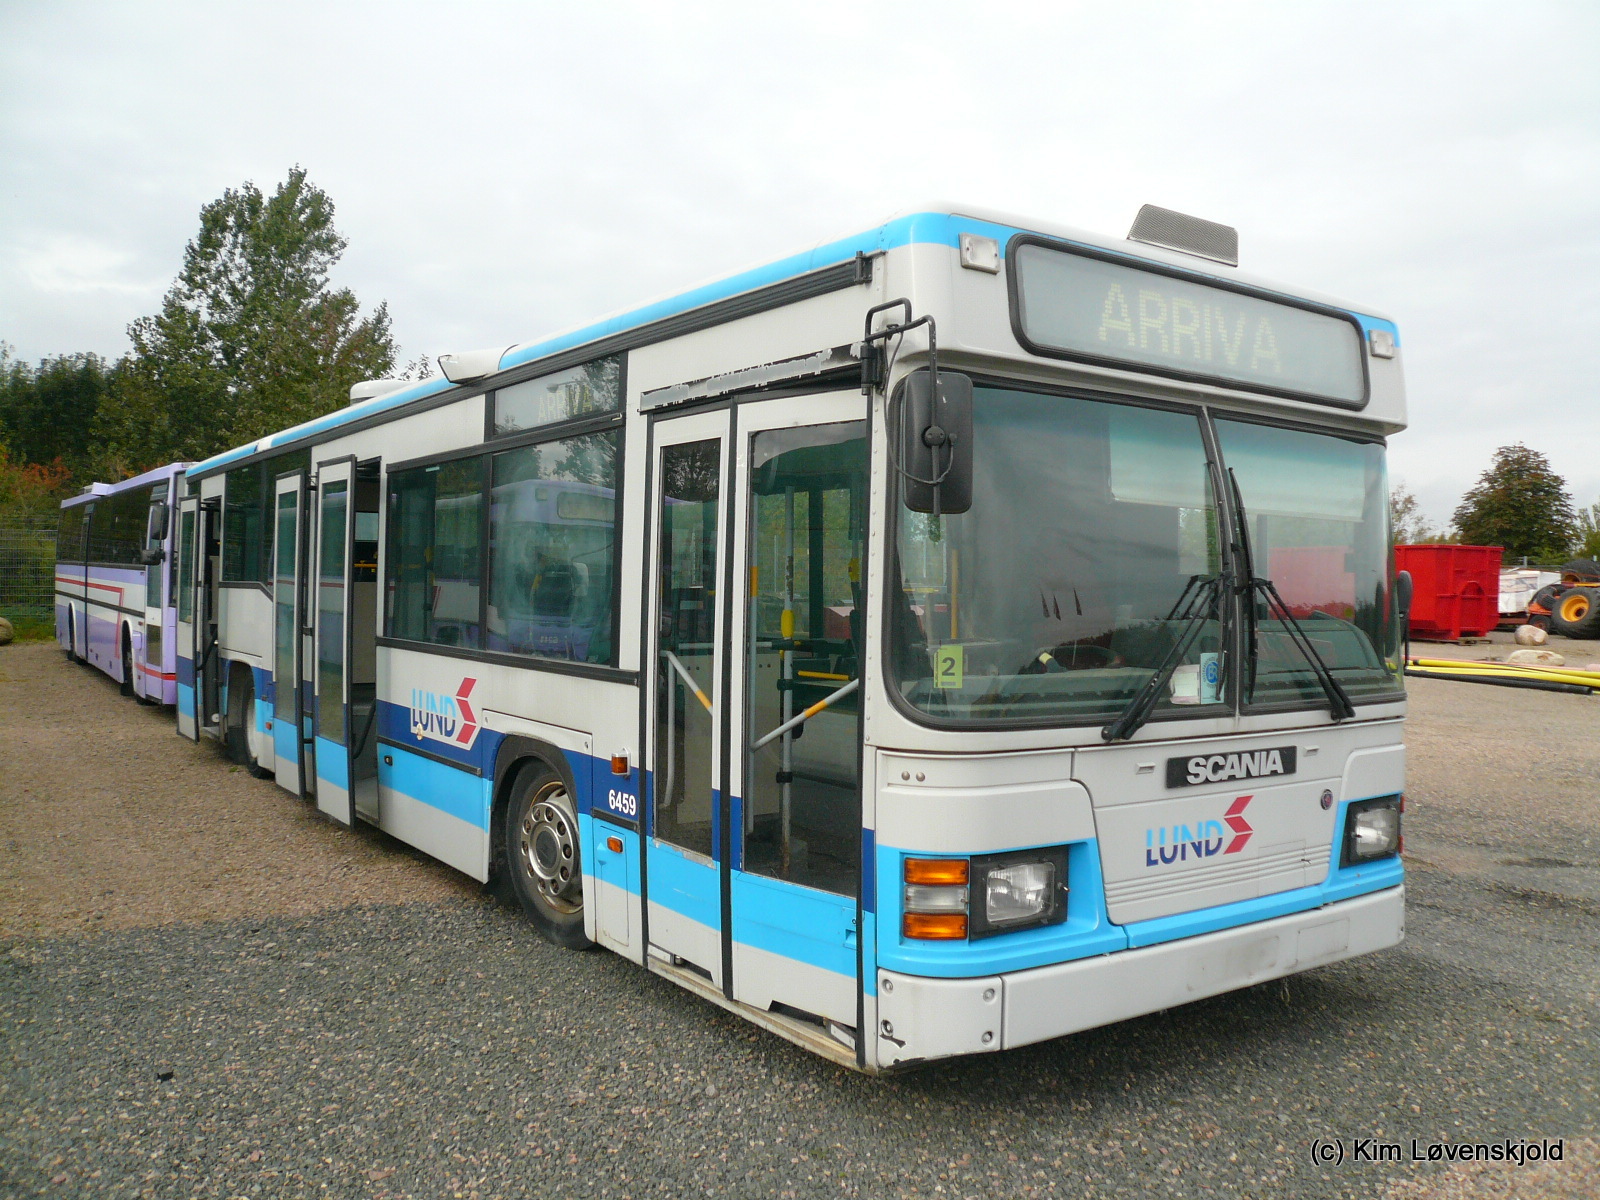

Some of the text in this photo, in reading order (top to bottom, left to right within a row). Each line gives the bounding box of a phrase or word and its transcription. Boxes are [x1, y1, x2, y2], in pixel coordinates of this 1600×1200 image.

[1098, 283, 1282, 373] ARRIVA
[941, 657, 956, 677] 2
[411, 688, 456, 738] LUND
[1186, 750, 1284, 784] SCANIA
[608, 789, 637, 816] 6459
[1146, 820, 1224, 867] LUND
